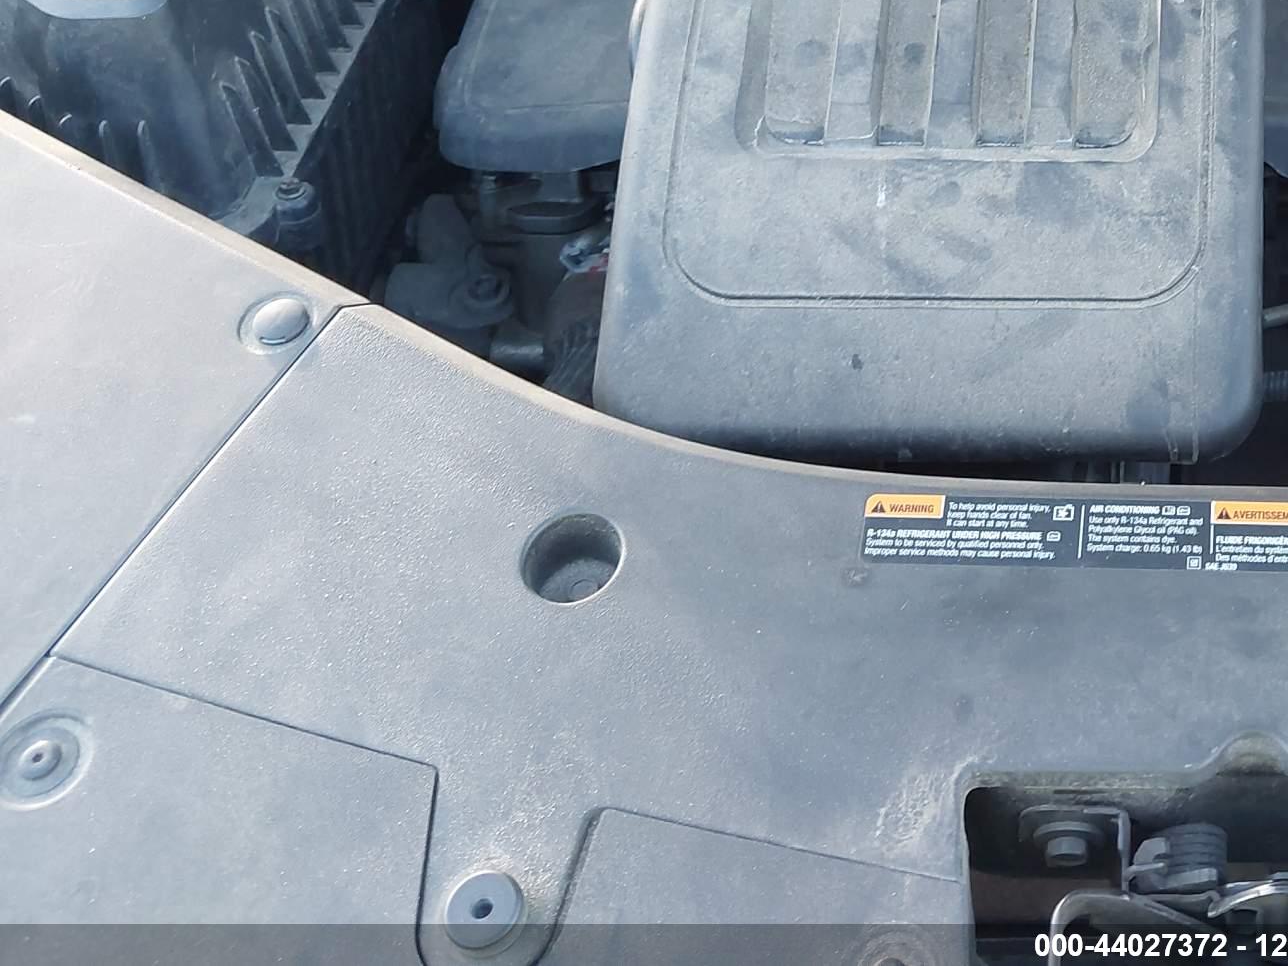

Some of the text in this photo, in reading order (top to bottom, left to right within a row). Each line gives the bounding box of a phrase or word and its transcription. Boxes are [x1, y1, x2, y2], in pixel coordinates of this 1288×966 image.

[889, 503, 934, 513] WARNING
[949, 502, 958, 511] To
[958, 502, 976, 512] help
[976, 503, 996, 511] avoid
[996, 504, 1028, 513] personal
[1089, 504, 1161, 515] AIR CONDITIONING
[947, 511, 966, 520] keep
[967, 511, 989, 519] hands
[990, 512, 1009, 520] clear
[1009, 511, 1018, 520] of
[968, 519, 986, 527] start
[995, 520, 1010, 529] any
[867, 528, 1044, 541] R-134a REFRIGERANT UNDER HIGH PRESSURE
[865, 537, 894, 548] System
[894, 538, 903, 547] to
[903, 538, 914, 547] be
[914, 539, 947, 548] serviced
[947, 539, 957, 549] by
[957, 540, 990, 550] qualified
[989, 541, 1026, 550] personnel
[1087, 543, 1114, 553] System
[1161, 544, 1171, 555] kg
[863, 546, 898, 557] Improper
[898, 548, 926, 556] service
[926, 548, 960, 557] methods
[959, 549, 977, 559] may
[977, 550, 1000, 558] cause
[1000, 550, 1033, 560] personal
